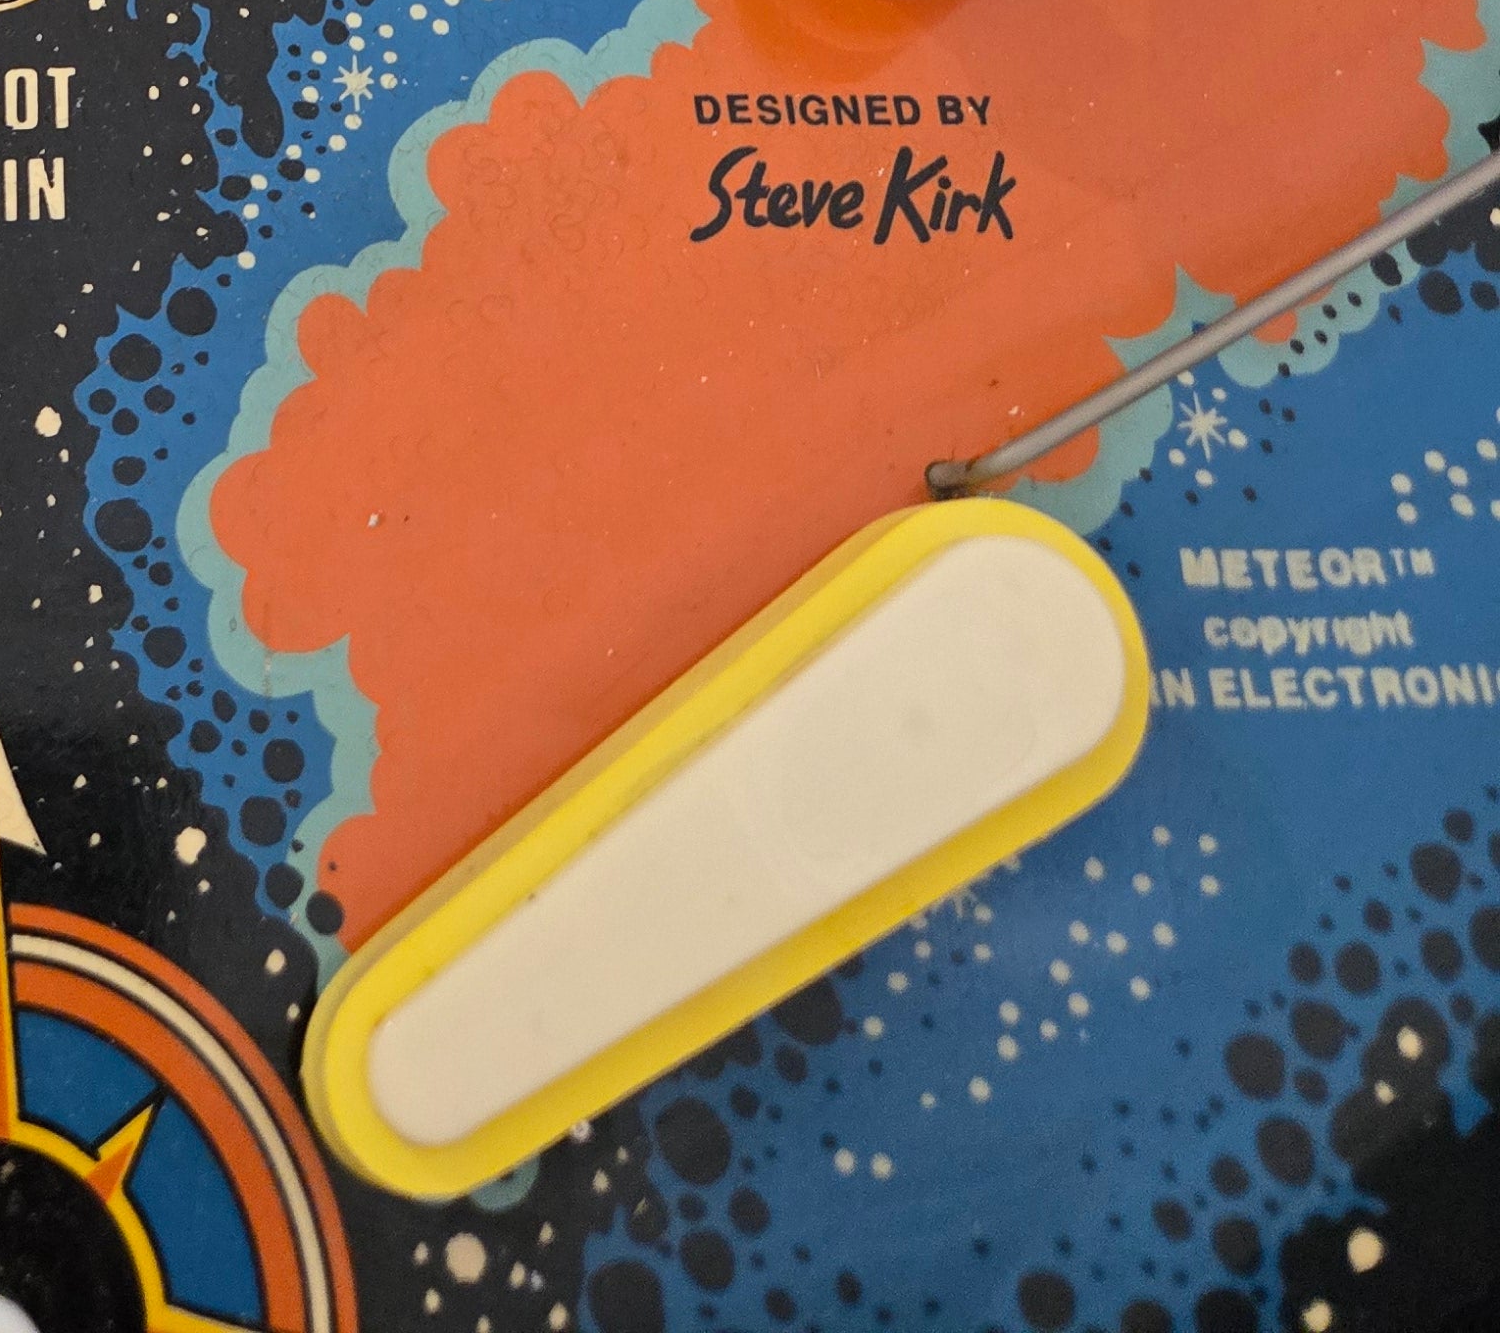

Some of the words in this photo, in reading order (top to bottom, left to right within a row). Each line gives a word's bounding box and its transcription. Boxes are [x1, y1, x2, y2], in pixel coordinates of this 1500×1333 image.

[692, 93, 922, 127] DESIGNED
[936, 94, 992, 127] BY
[688, 145, 867, 244] Steve
[872, 145, 1018, 247] Kirk
[1203, 609, 1415, 657] copyright
[1208, 663, 1500, 710] ELECTRONI
